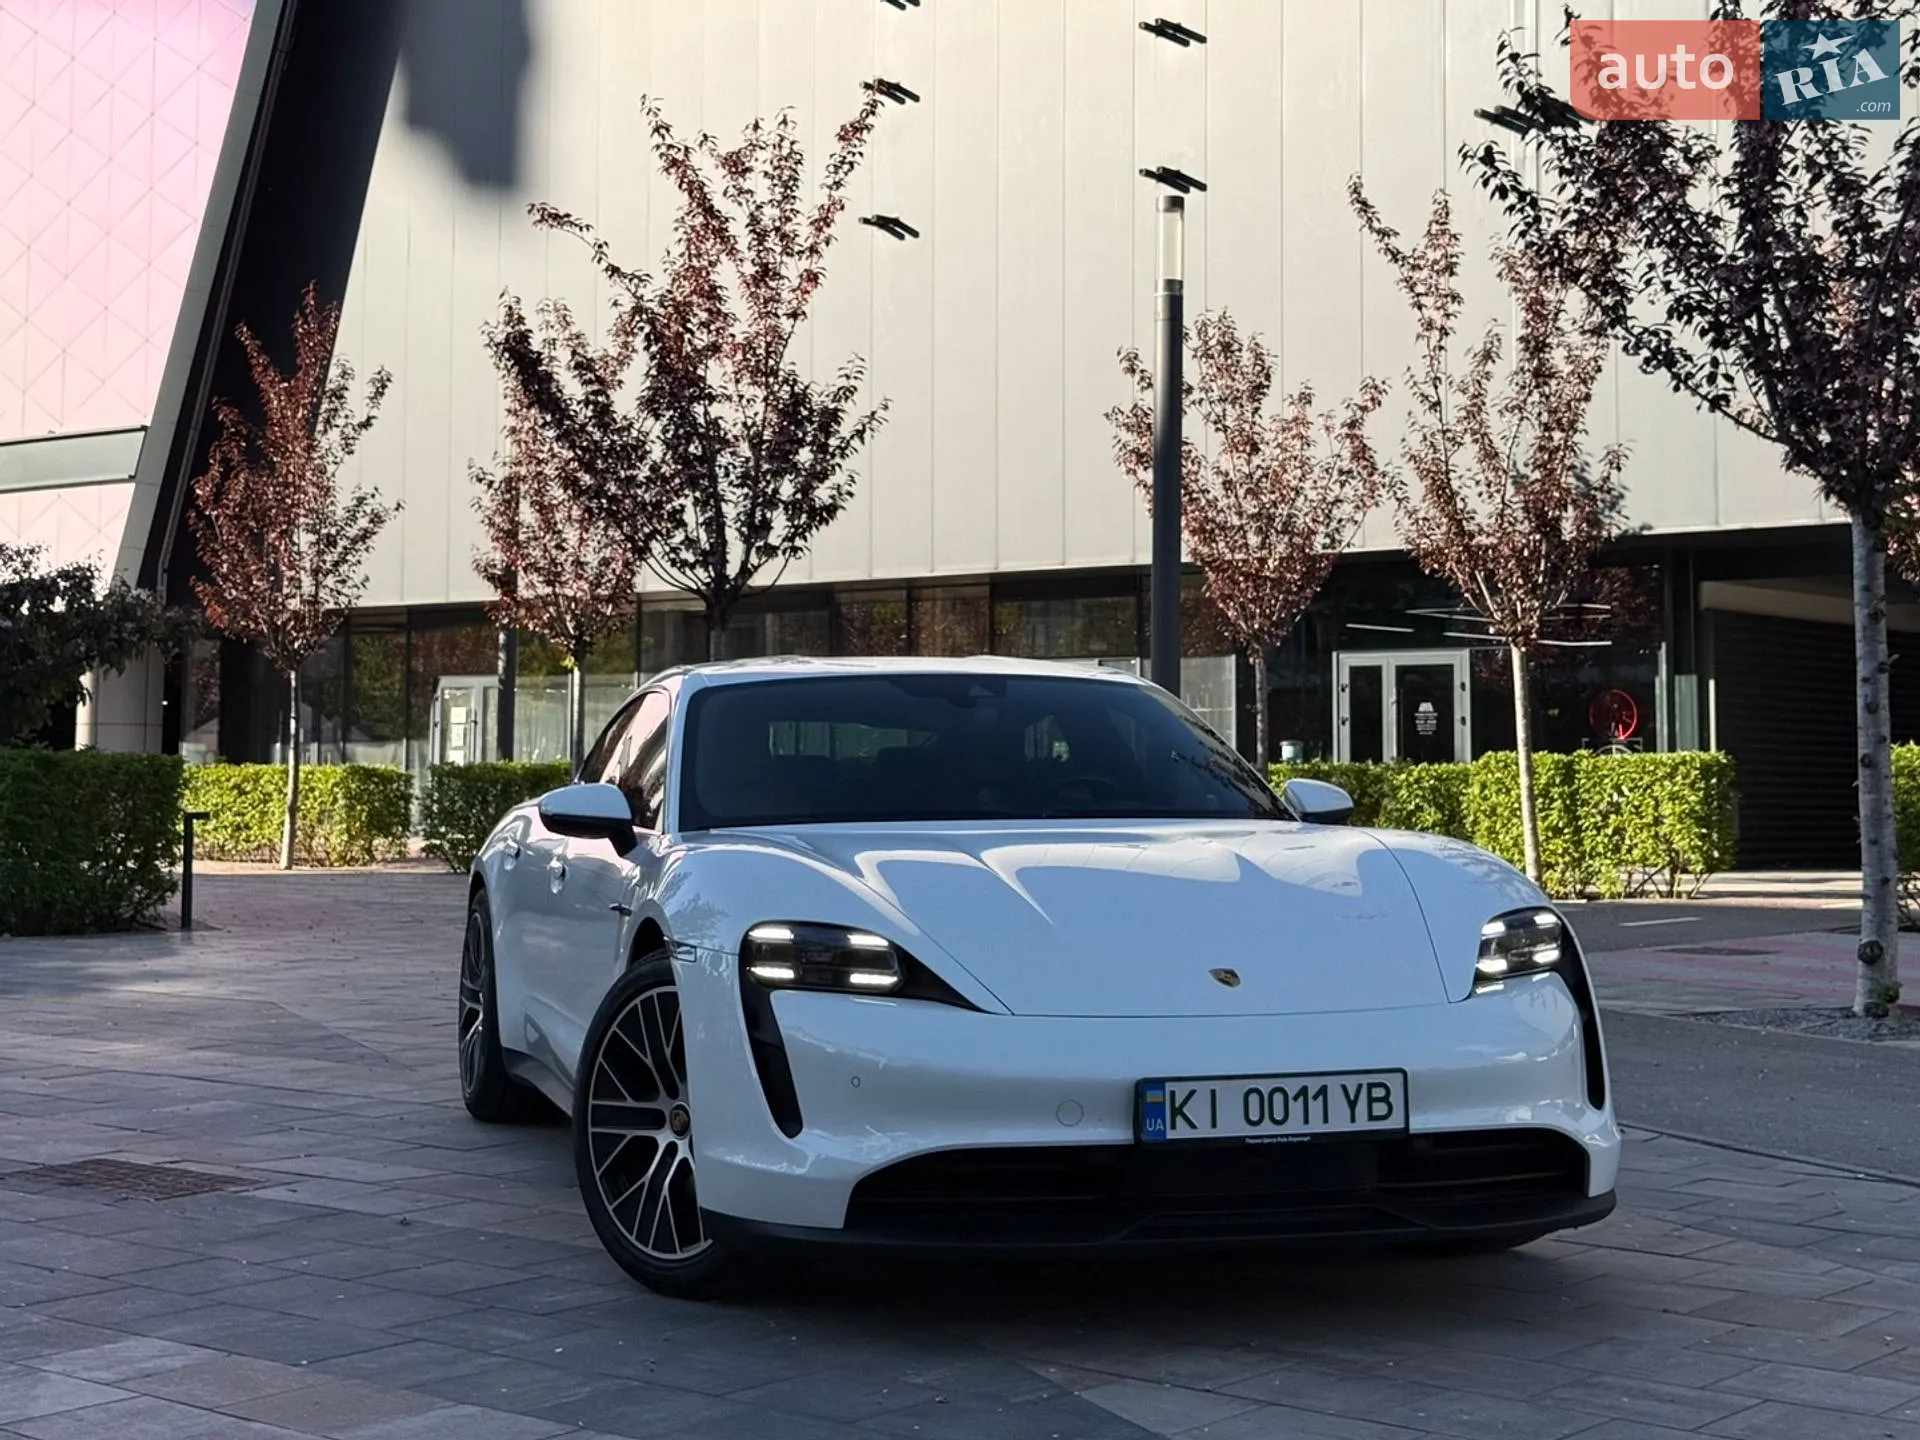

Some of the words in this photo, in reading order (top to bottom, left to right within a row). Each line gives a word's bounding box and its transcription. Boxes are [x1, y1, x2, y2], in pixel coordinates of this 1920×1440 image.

[1169, 1089, 1217, 1130] KI
[1243, 1085, 1328, 1127] 0011
[1341, 1081, 1394, 1124] YB
[1146, 1118, 1165, 1132] UA
